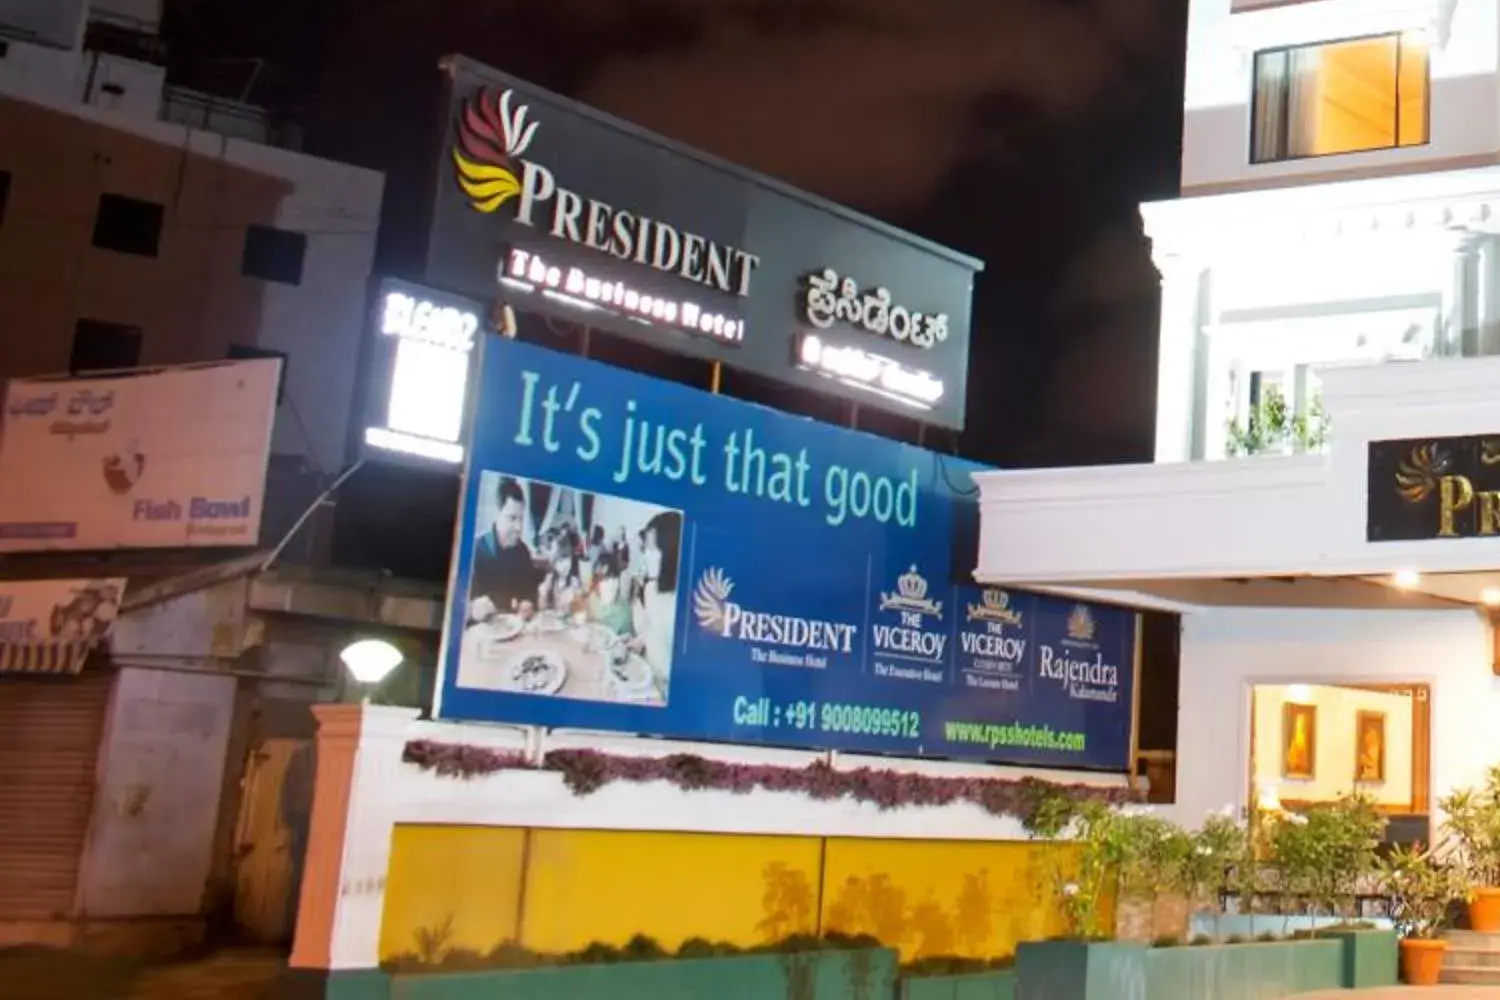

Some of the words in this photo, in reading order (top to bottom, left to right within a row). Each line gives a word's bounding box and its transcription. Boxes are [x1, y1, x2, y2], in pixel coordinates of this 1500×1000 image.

[513, 159, 760, 297] PRESIDENT
[511, 248, 561, 288] The
[681, 301, 745, 342] Hotel
[514, 370, 602, 462] It's
[613, 401, 707, 486] just
[724, 428, 811, 506] that
[824, 465, 919, 528] good
[722, 601, 857, 653] PRESIDENT
[901, 611, 922, 629] THE
[986, 622, 1003, 635] THE
[1040, 645, 1118, 690] Rajendra
[734, 696, 770, 727] Call
[785, 702, 816, 729] +91
[821, 702, 920, 738] 9008099512
